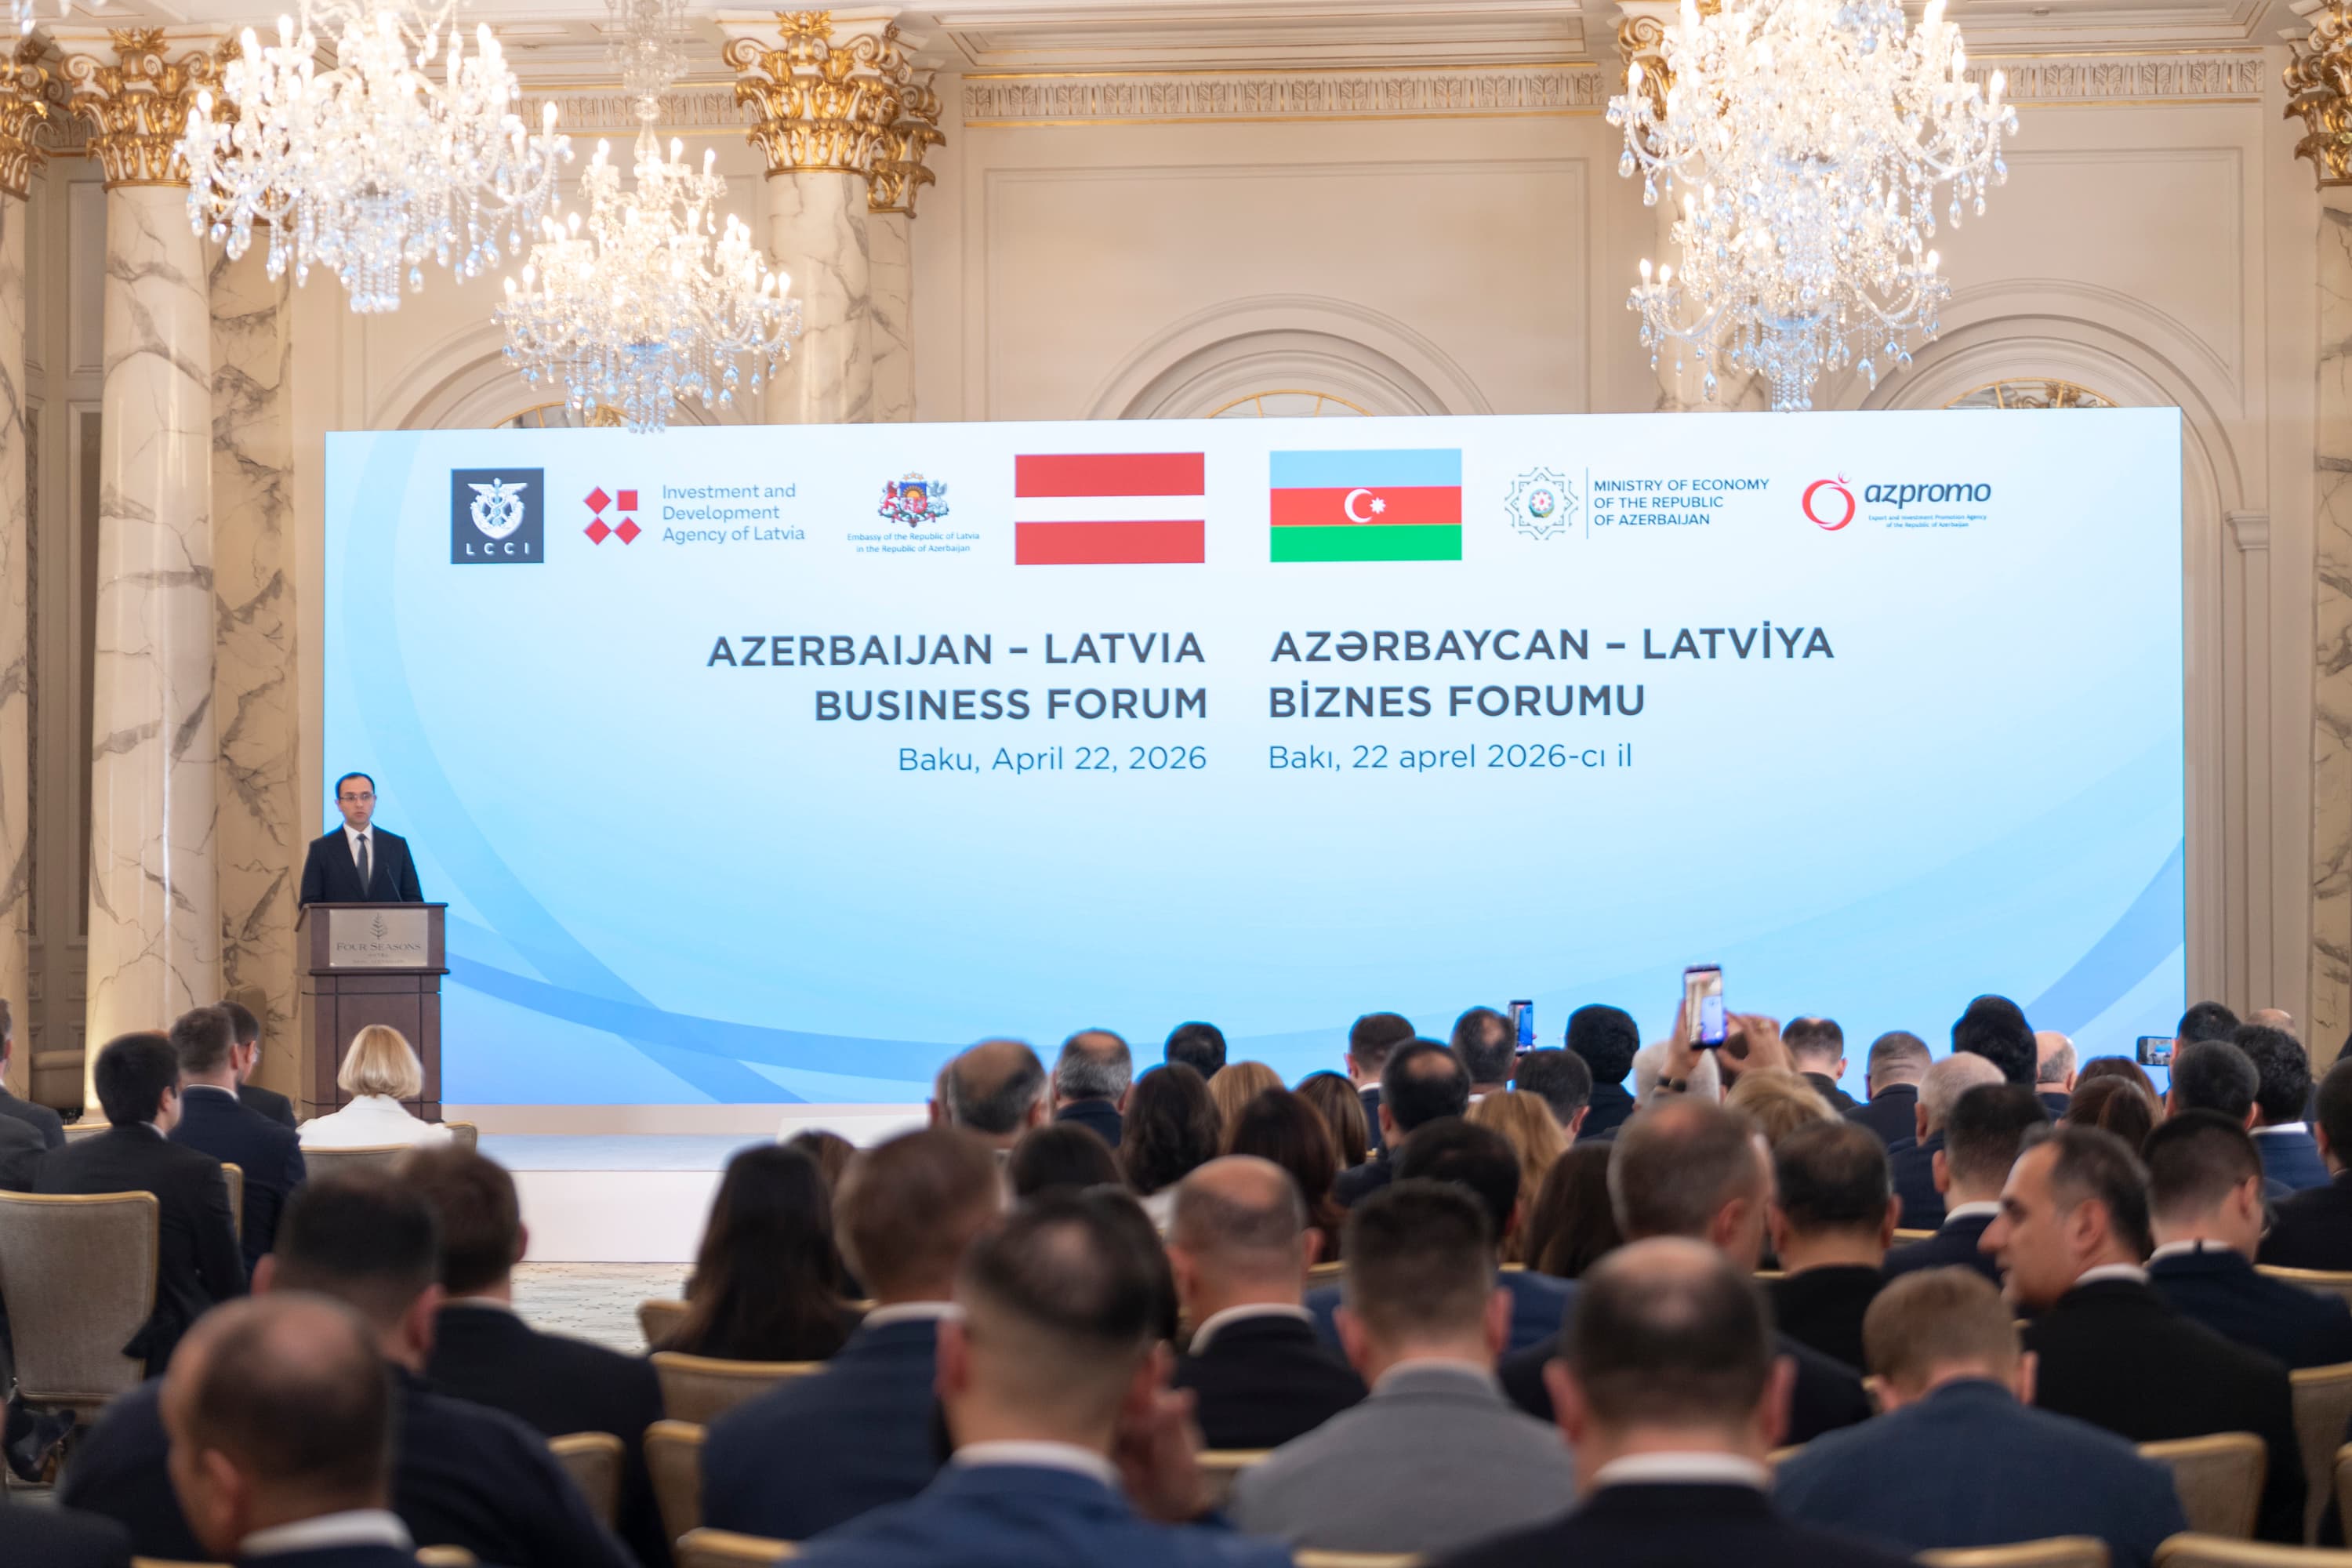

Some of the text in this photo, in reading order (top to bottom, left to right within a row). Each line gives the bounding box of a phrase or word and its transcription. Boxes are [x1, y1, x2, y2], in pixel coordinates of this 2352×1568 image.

[662, 482, 797, 499] Investment and
[1594, 478, 1769, 492] MINISTRY OF ECONOMY
[1594, 495, 1724, 509] OF THE REPUBLIC
[1864, 483, 1991, 510] azpromo
[662, 505, 780, 524] Development
[1594, 514, 1710, 526] OF AZERBAIJAN
[662, 524, 805, 546] Agency of Latvia
[847, 532, 980, 542] Embassy of the Republic of Latvia
[466, 542, 529, 555] LCCI
[881, 545, 916, 554] Republic
[917, 544, 927, 553] of
[928, 545, 971, 554] Azerbaijan
[706, 633, 992, 667] AZERBAIJAN
[1045, 632, 1205, 664] LATVIA
[1270, 629, 1588, 662] AZƏRBAYCAN
[1643, 620, 1835, 659] LATVİYA
[815, 688, 1207, 721] BUSINESS FORUM
[1269, 680, 1644, 718] BİZNES FORUMU
[899, 746, 1207, 775] Baku, April 22, 2026
[1269, 742, 1632, 773] Bakı, 22 aprel 2026-cı il
[337, 942, 421, 951] FOUR SEASONS
